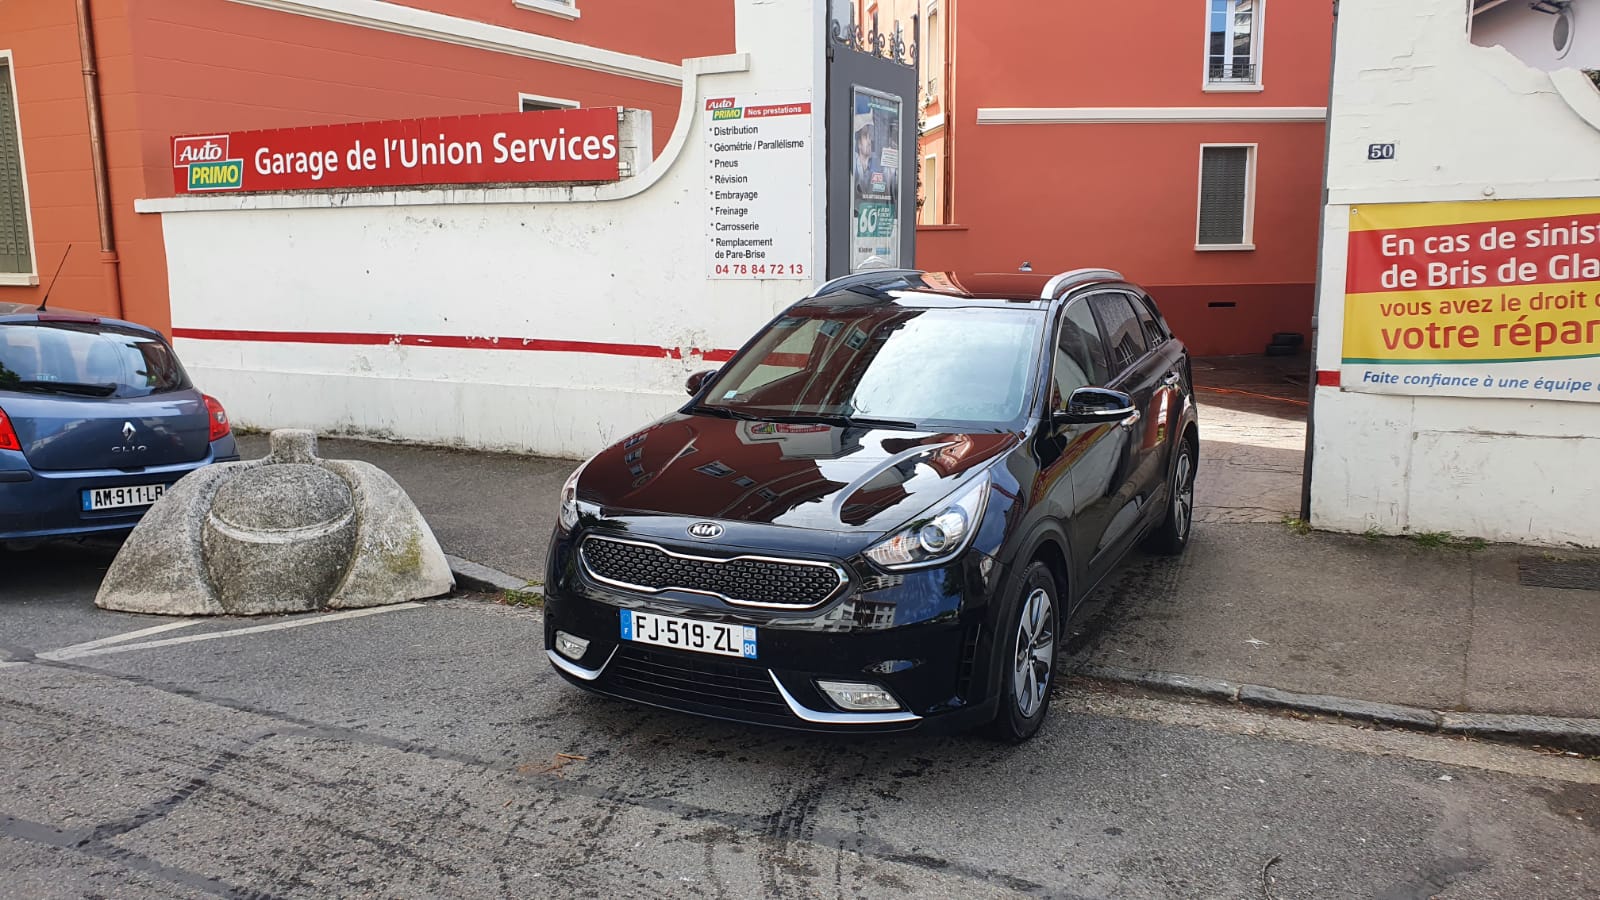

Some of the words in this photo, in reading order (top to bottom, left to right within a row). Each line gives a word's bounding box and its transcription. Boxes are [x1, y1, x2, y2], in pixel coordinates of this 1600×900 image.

[708, 100, 732, 109] Auto
[714, 109, 741, 119] PRIMO
[762, 106, 802, 116] prestations
[714, 126, 758, 136] Distribution
[714, 142, 752, 152] Géométrie
[757, 139, 804, 150] Parallélisme
[1371, 144, 1394, 158] 50
[179, 143, 223, 163] Auto
[254, 146, 338, 180] Garage
[346, 139, 377, 170] de
[383, 136, 483, 169] l'Union
[493, 128, 616, 164] Services
[715, 159, 738, 168] Pneus
[192, 165, 239, 185] PRIMO
[714, 174, 748, 184] Révision
[715, 190, 758, 201] Embrayage
[715, 206, 748, 217] Freinage
[715, 222, 759, 231] Carrosserie
[715, 238, 773, 248] Remplacement
[1382, 234, 1414, 256] En
[1424, 233, 1470, 253] cas
[1479, 227, 1516, 250] de
[715, 250, 724, 259] de
[726, 250, 766, 259] Pare-Brise
[715, 264, 729, 274] 04
[733, 264, 747, 274] 78
[751, 264, 765, 274] 84
[770, 264, 784, 274] 72
[789, 264, 803, 274] 13
[1381, 264, 1417, 289] de
[1428, 260, 1487, 287] Bris
[1497, 257, 1538, 283] de
[1548, 253, 1600, 280] Gla
[1380, 301, 1432, 317] vous
[1439, 298, 1493, 315] avez
[1500, 293, 1521, 312] le
[1529, 290, 1587, 311] droit
[1381, 322, 1479, 350] votre
[1493, 315, 1600, 352] répar
[1363, 371, 1399, 384] Faite
[1403, 372, 1479, 388] confiance
[1483, 375, 1493, 388] à
[1498, 378, 1529, 389] une
[1533, 376, 1592, 393] équipe
[692, 525, 716, 536] KIA
[636, 615, 740, 653] FJ-519-ZL
[744, 643, 757, 656] 80
